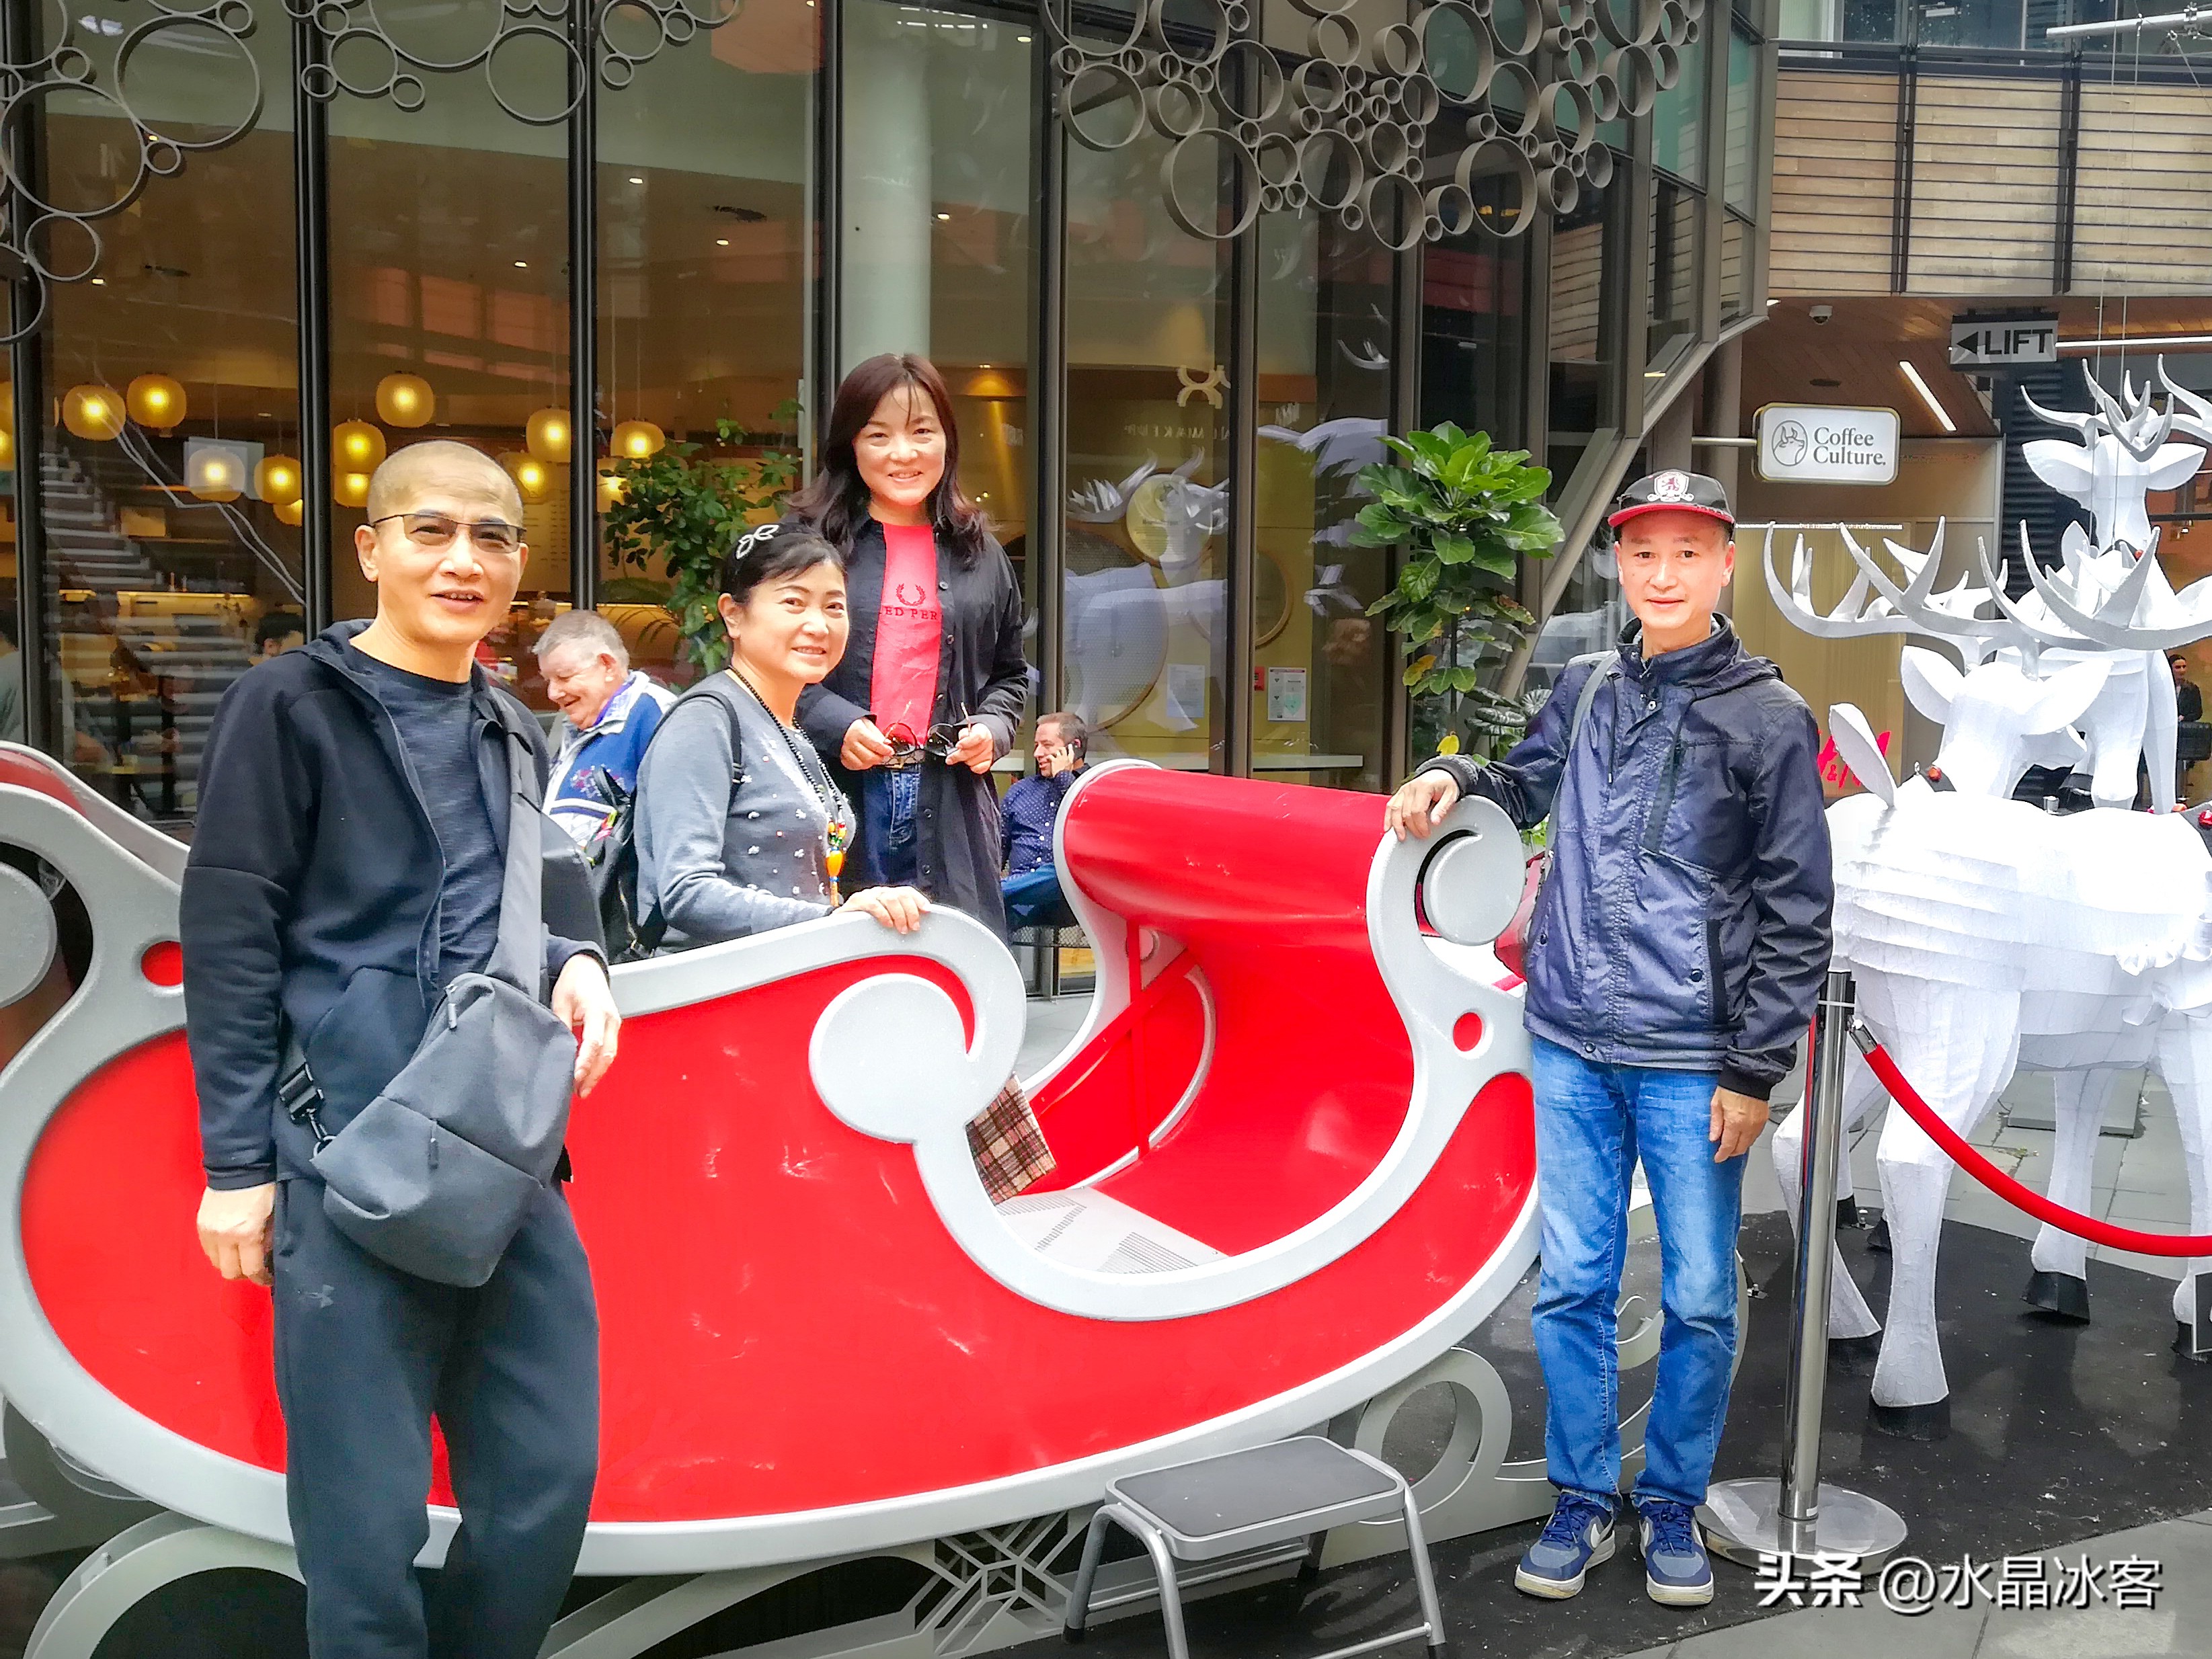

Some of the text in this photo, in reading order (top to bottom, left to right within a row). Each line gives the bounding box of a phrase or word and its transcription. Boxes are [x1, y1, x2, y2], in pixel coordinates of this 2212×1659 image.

[1983, 328, 2053, 356] LIFT
[1813, 426, 1874, 446] Coffee
[1813, 446, 1887, 465] Culture.
[880, 606, 904, 616] ED
